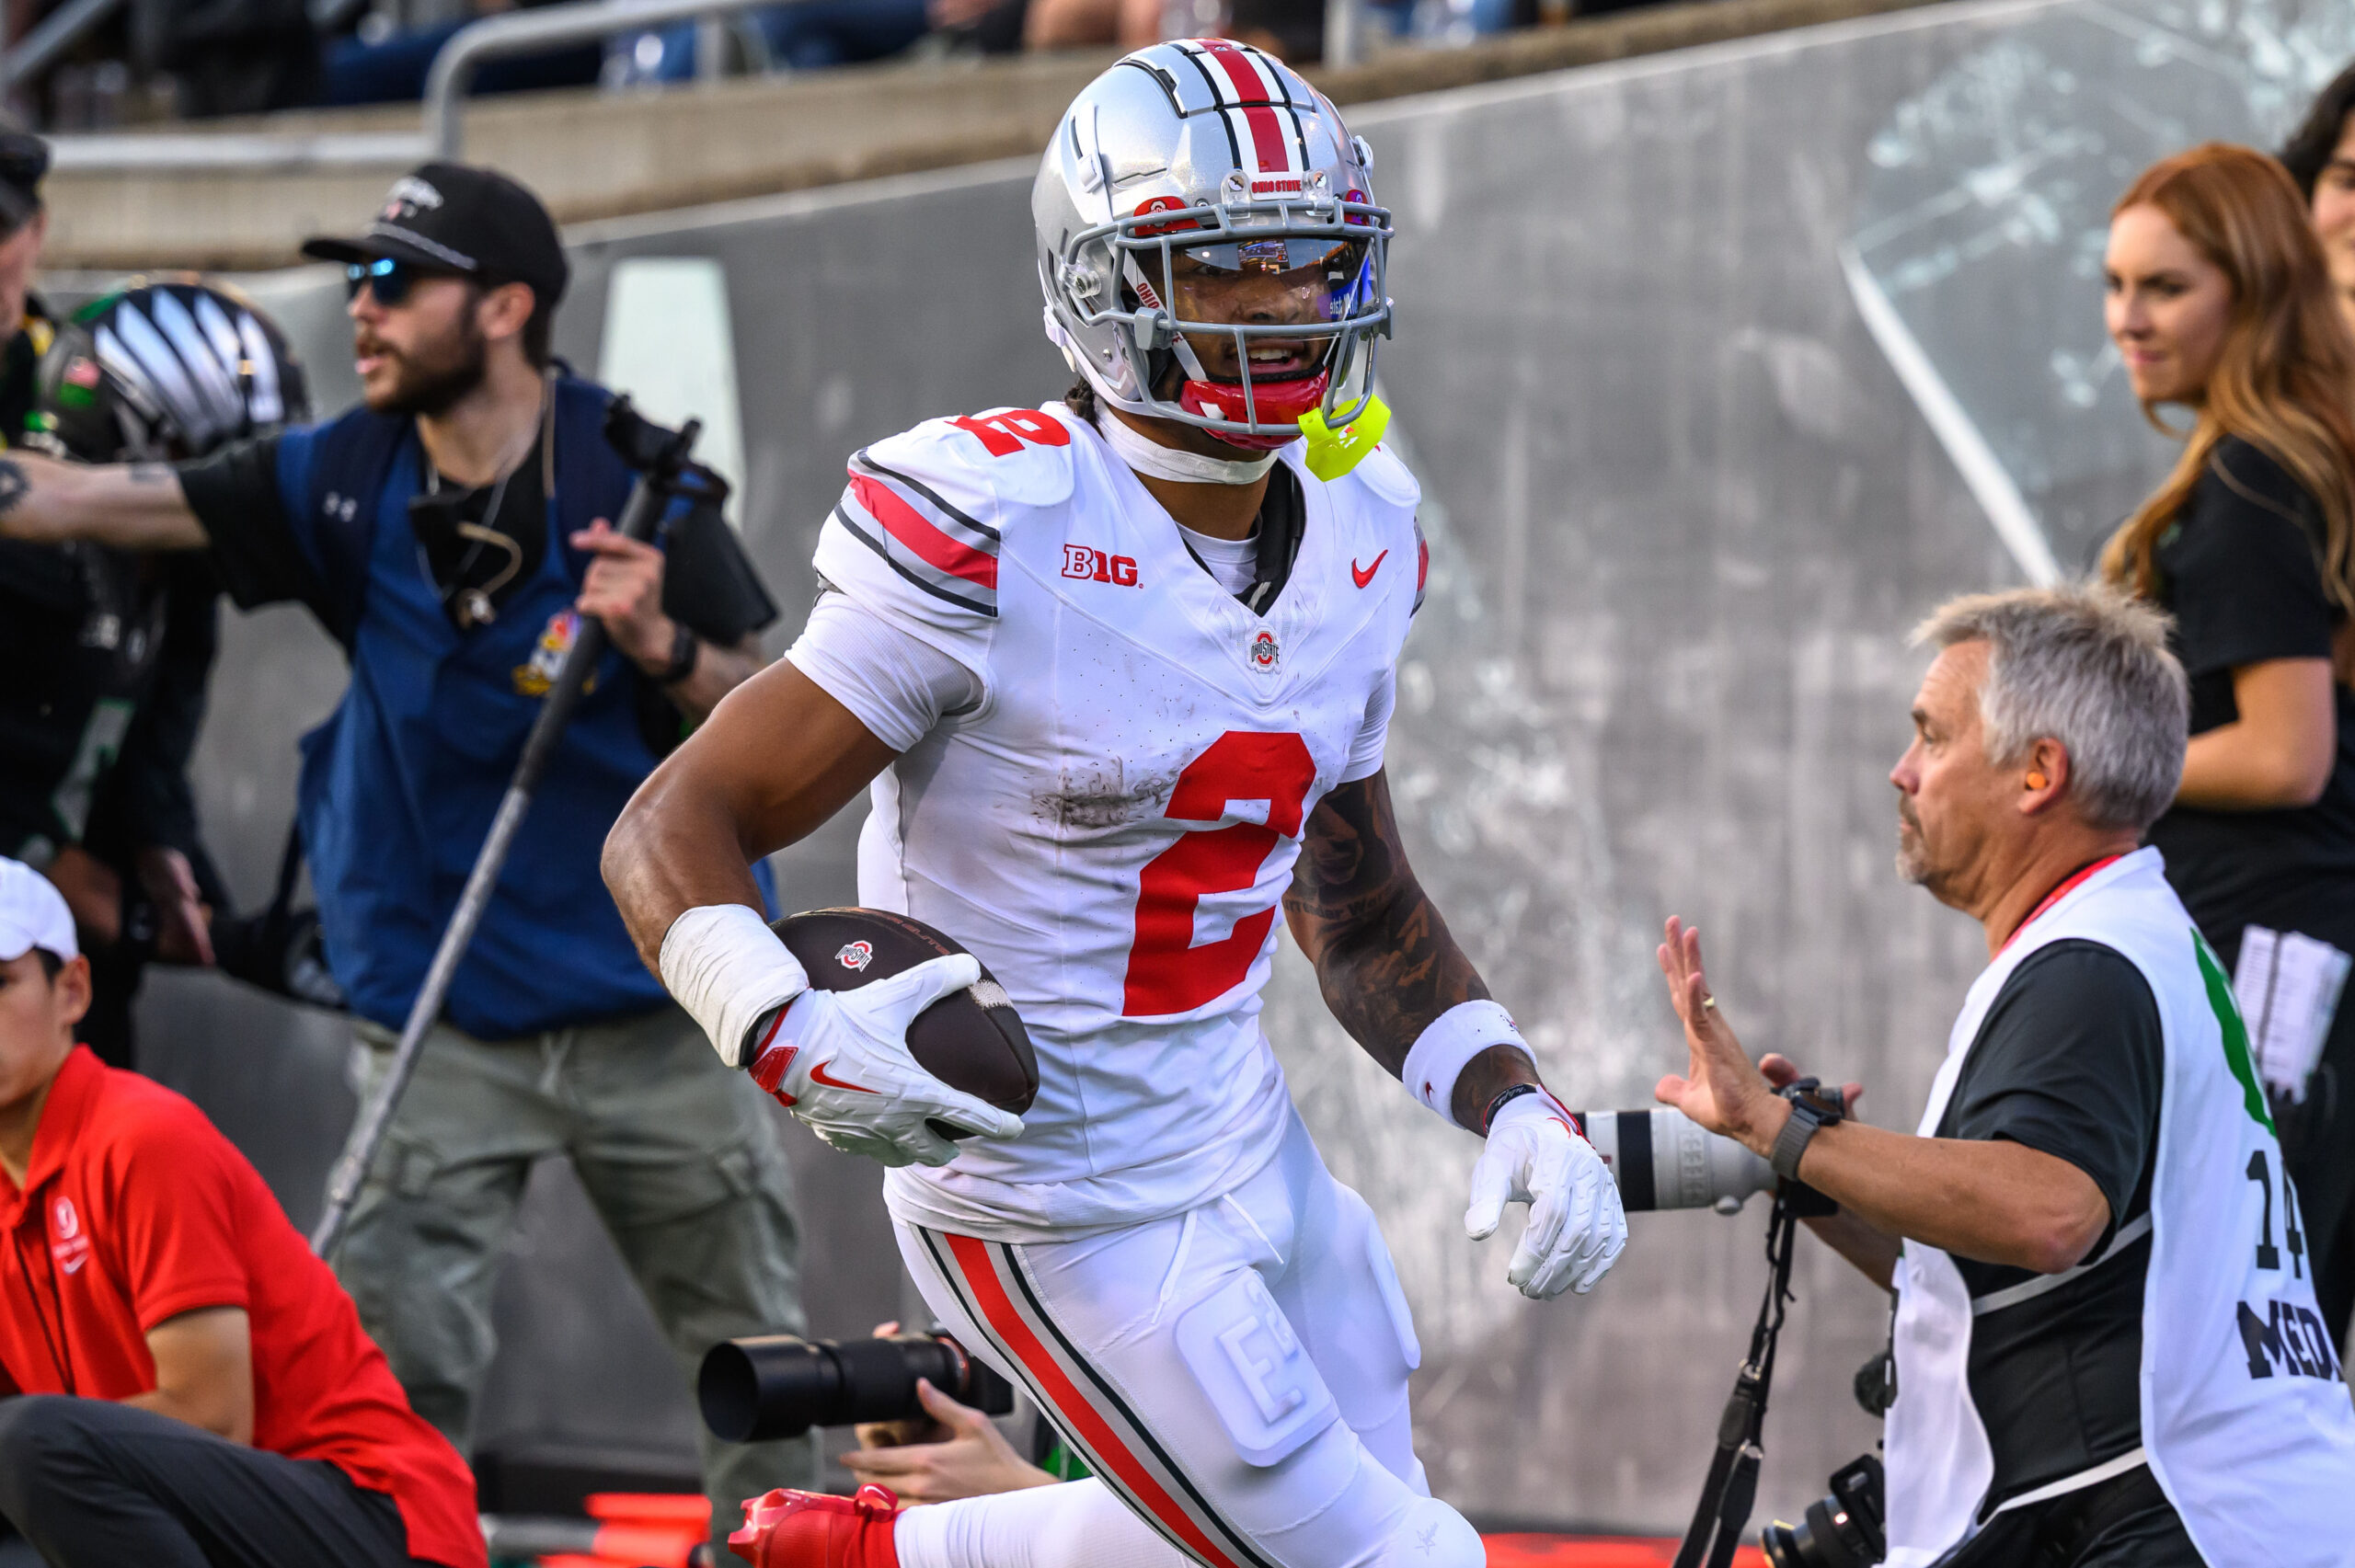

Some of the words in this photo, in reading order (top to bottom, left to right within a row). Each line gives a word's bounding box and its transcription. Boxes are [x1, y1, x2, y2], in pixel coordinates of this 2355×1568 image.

[1251, 180, 1275, 193] OHIO
[1275, 179, 1303, 192] STATE
[1135, 281, 1160, 309] OHIO
[1121, 730, 1317, 1016] 2
[2246, 1150, 2304, 1279] 14
